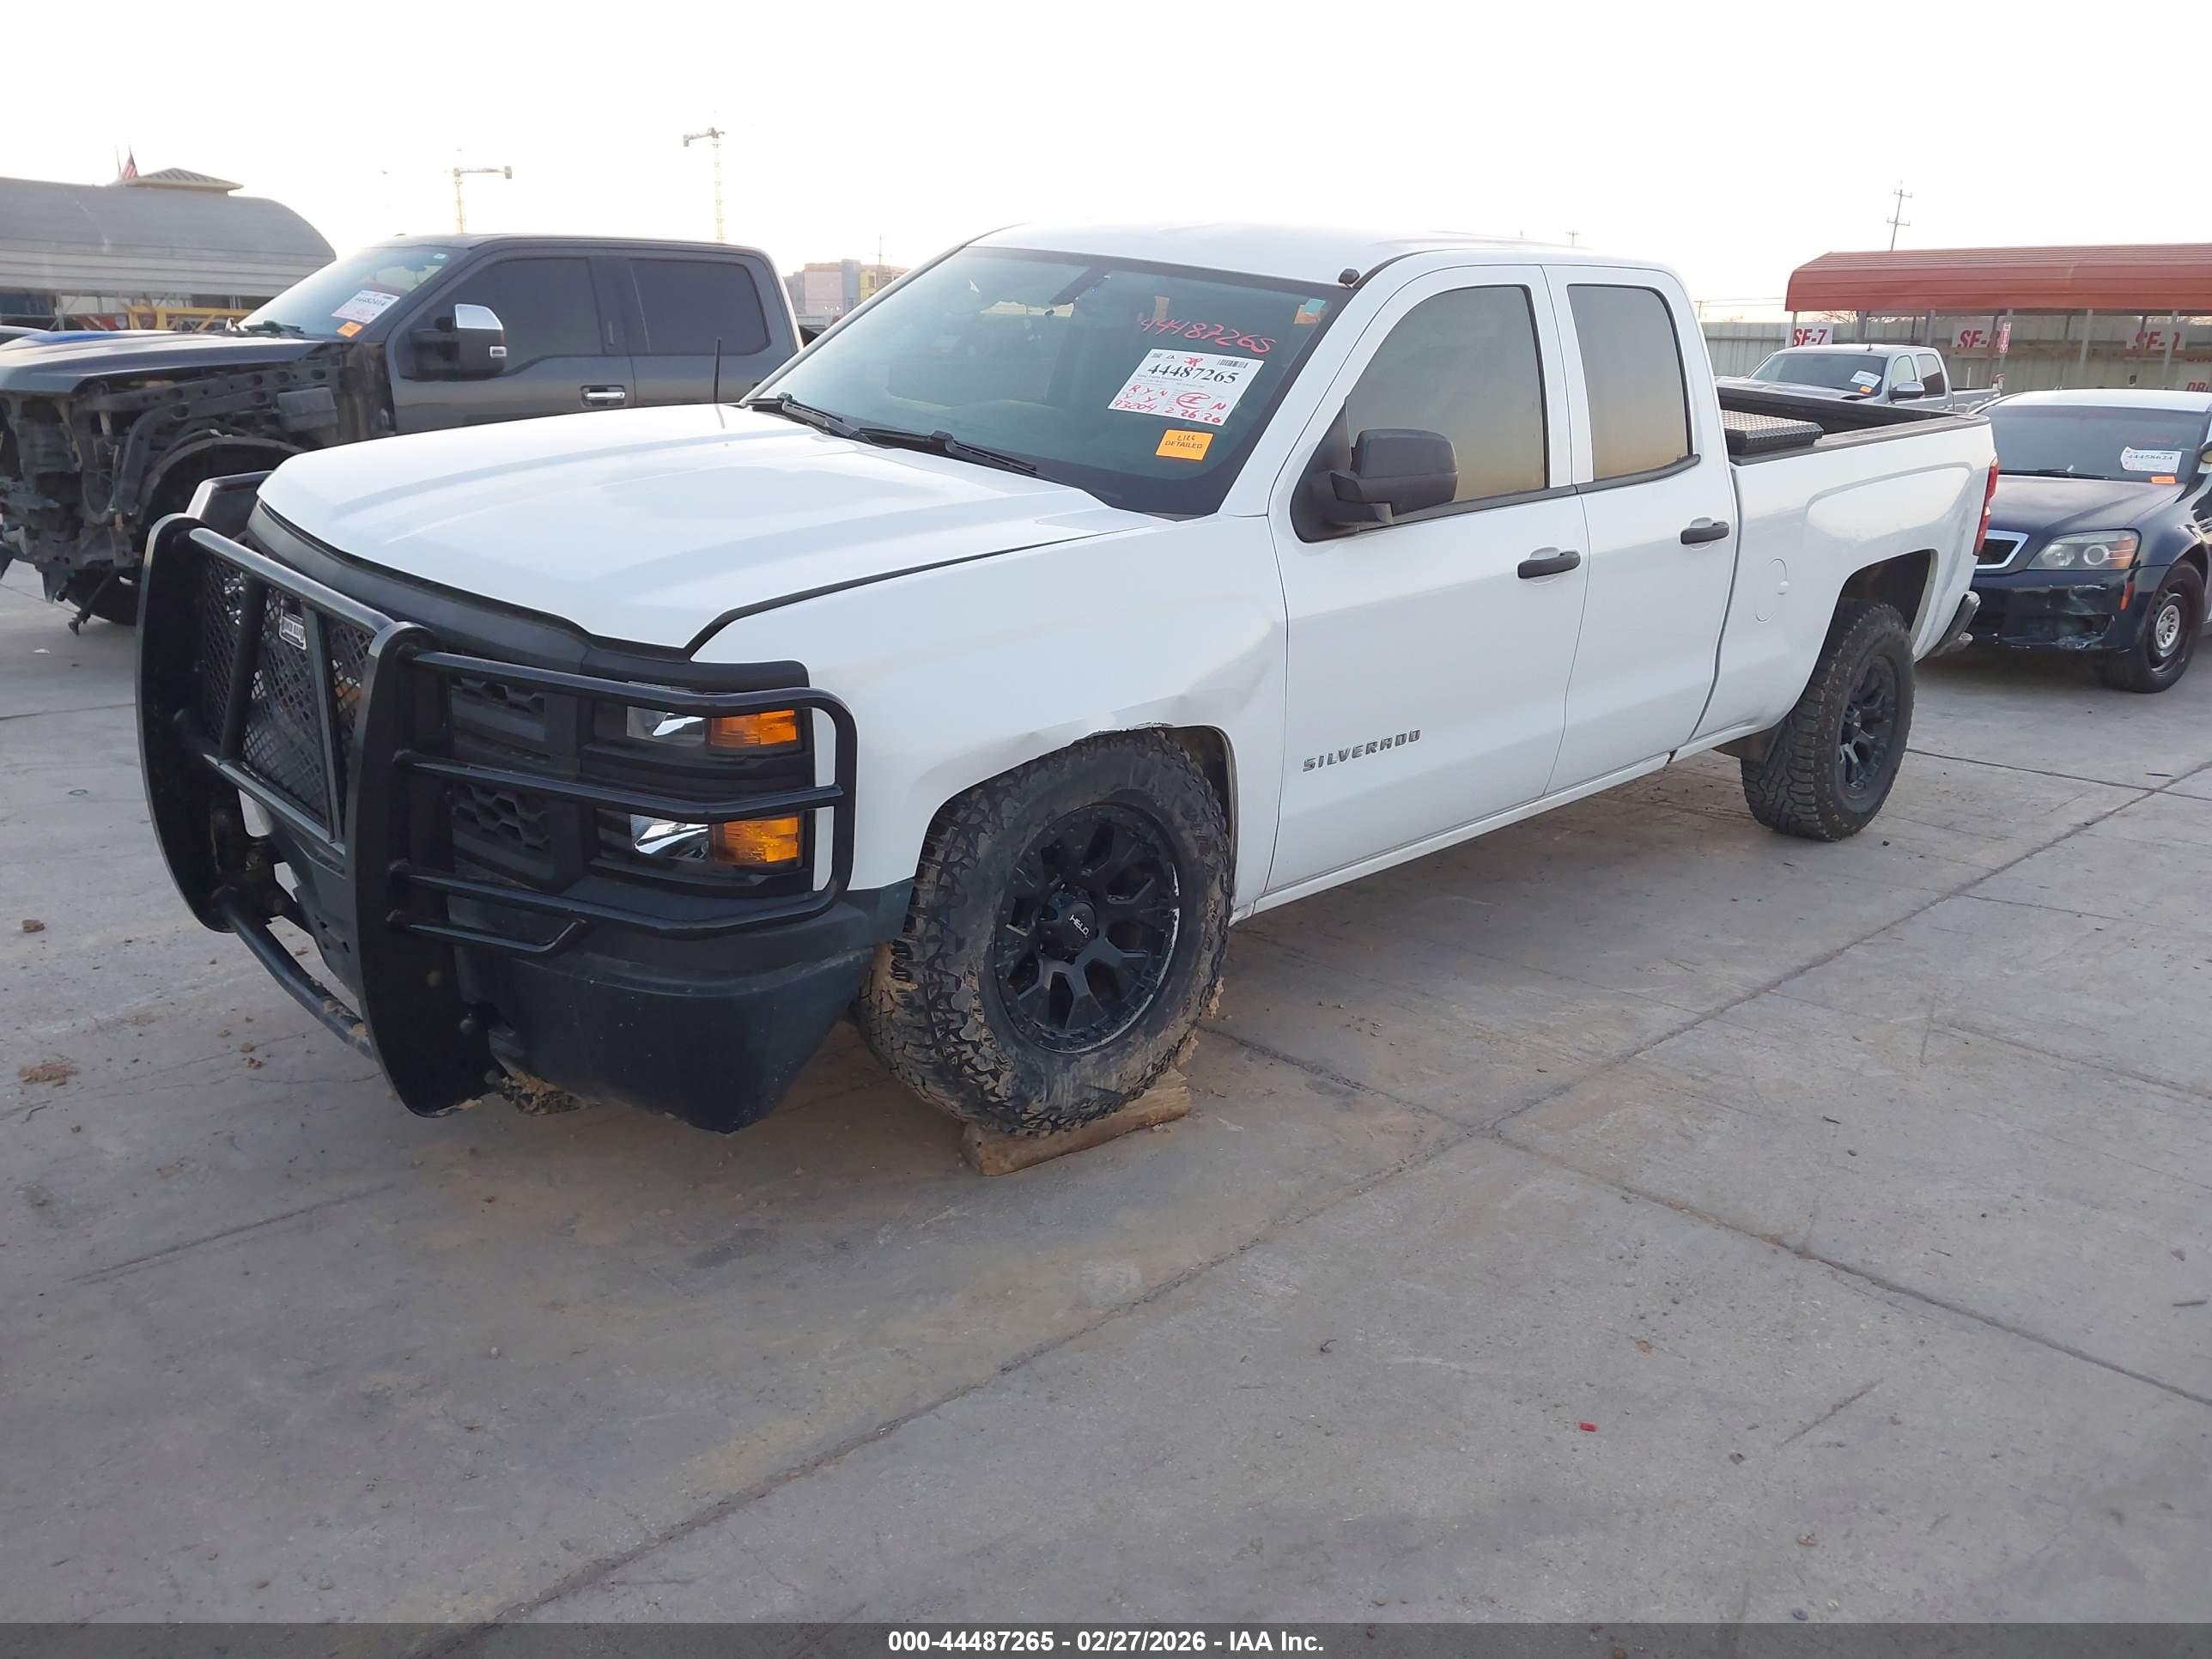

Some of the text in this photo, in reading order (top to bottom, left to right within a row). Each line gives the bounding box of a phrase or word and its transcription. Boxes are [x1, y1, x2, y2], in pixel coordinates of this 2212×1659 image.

[1140, 318, 1277, 354] 44487265
[1147, 363, 1239, 384] 44487265
[1164, 440, 1203, 449] DETAILED
[1303, 729, 1421, 773] SILVERADO
[1069, 914, 1090, 936] HELO
